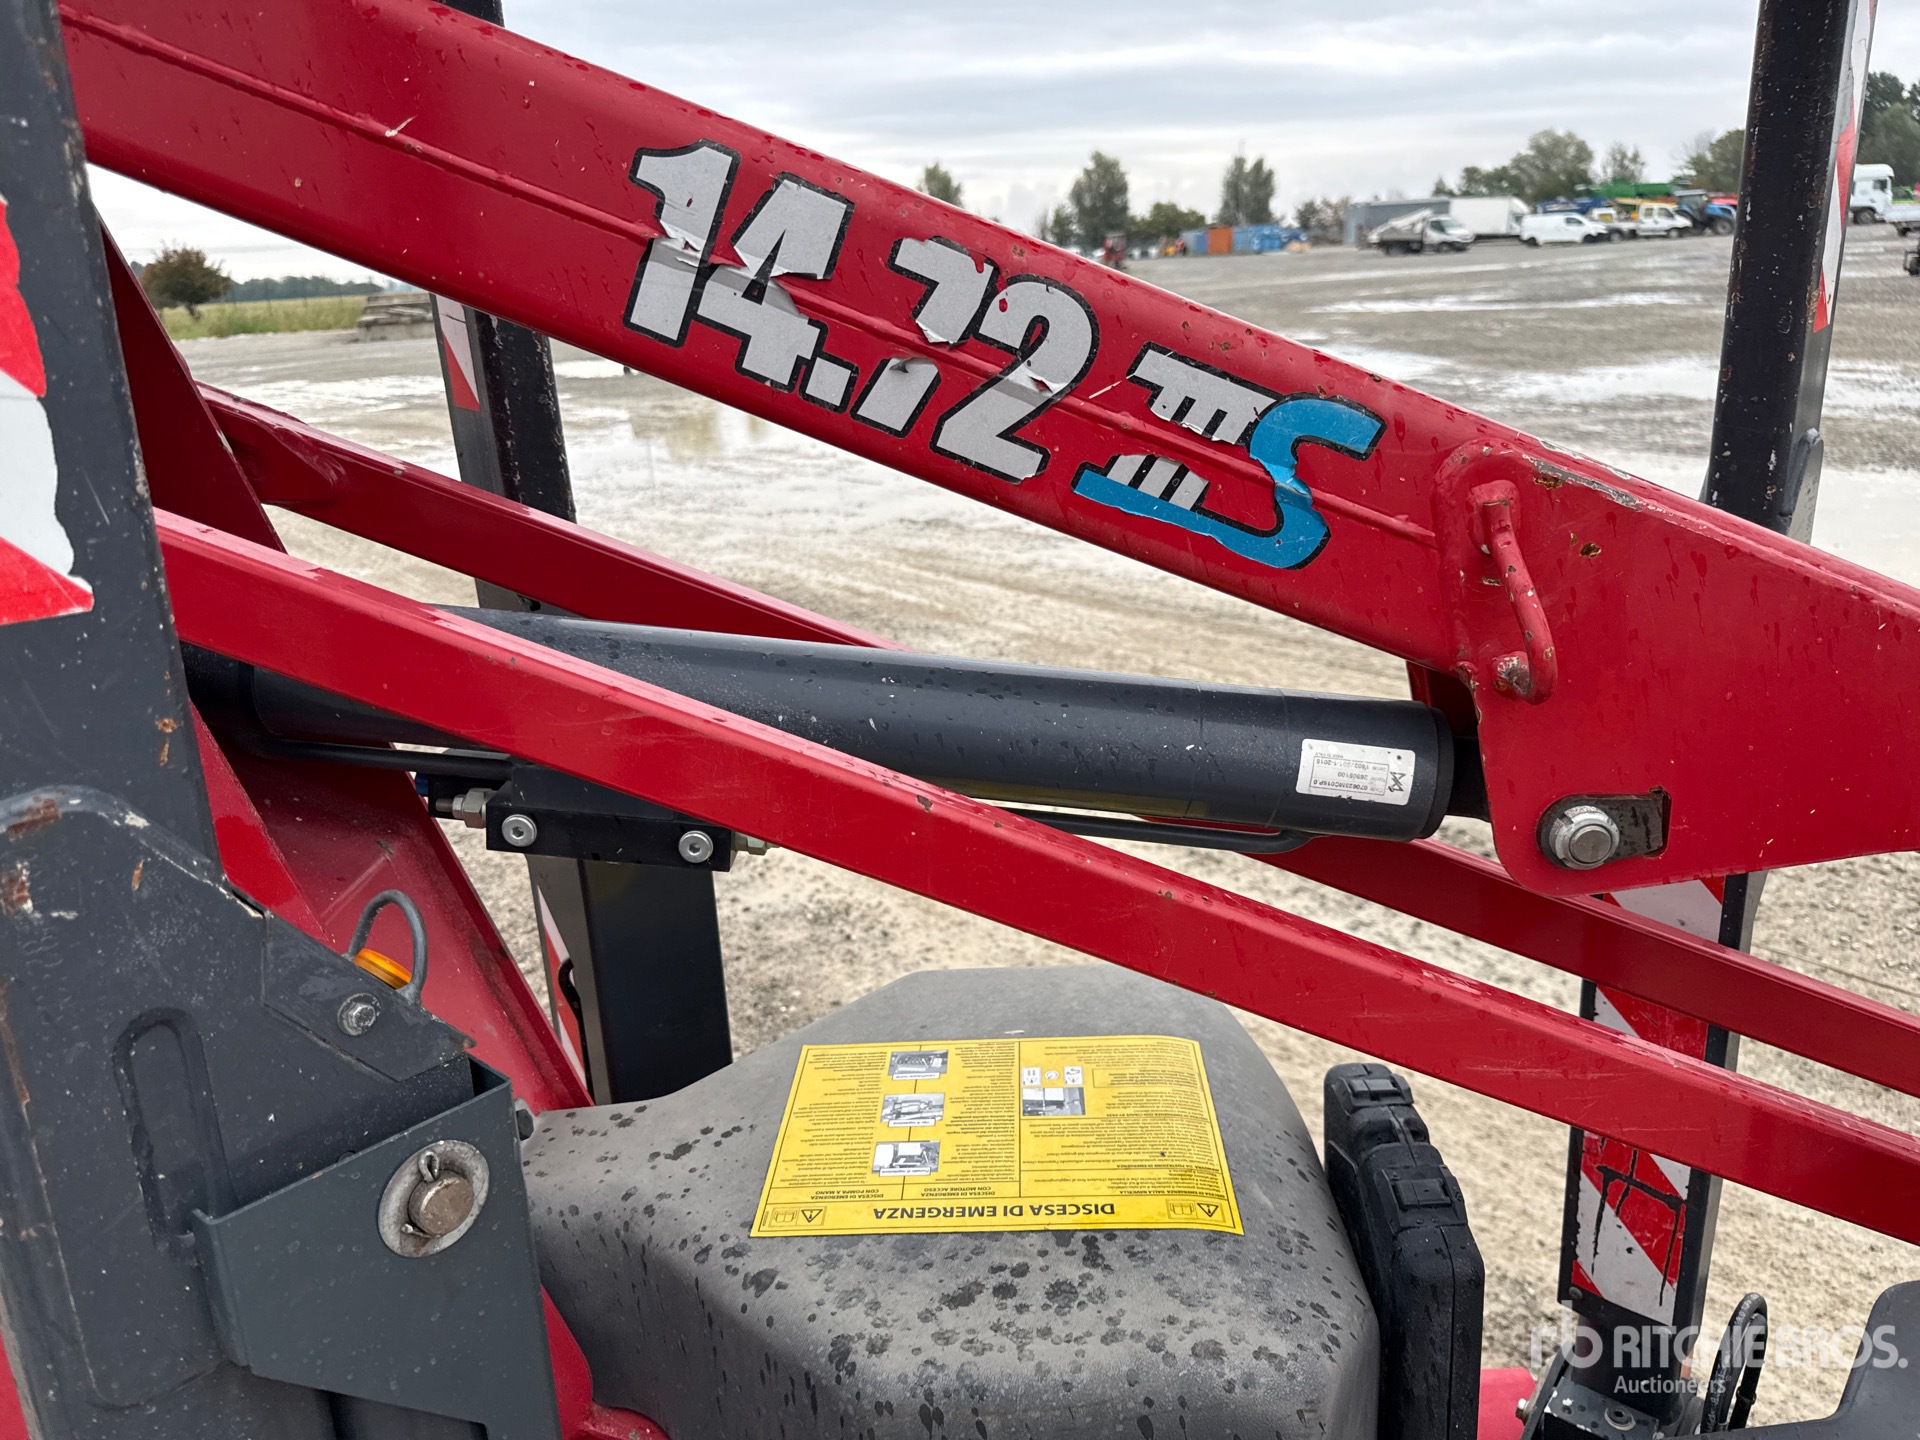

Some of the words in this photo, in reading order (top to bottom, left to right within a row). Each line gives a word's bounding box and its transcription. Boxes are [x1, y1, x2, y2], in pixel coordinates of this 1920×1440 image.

[622, 139, 1101, 484] 14.72
[873, 1205, 997, 1219] EMERGENZA
[1003, 1205, 1022, 1217] DI
[1030, 1203, 1115, 1216] DISCESA
